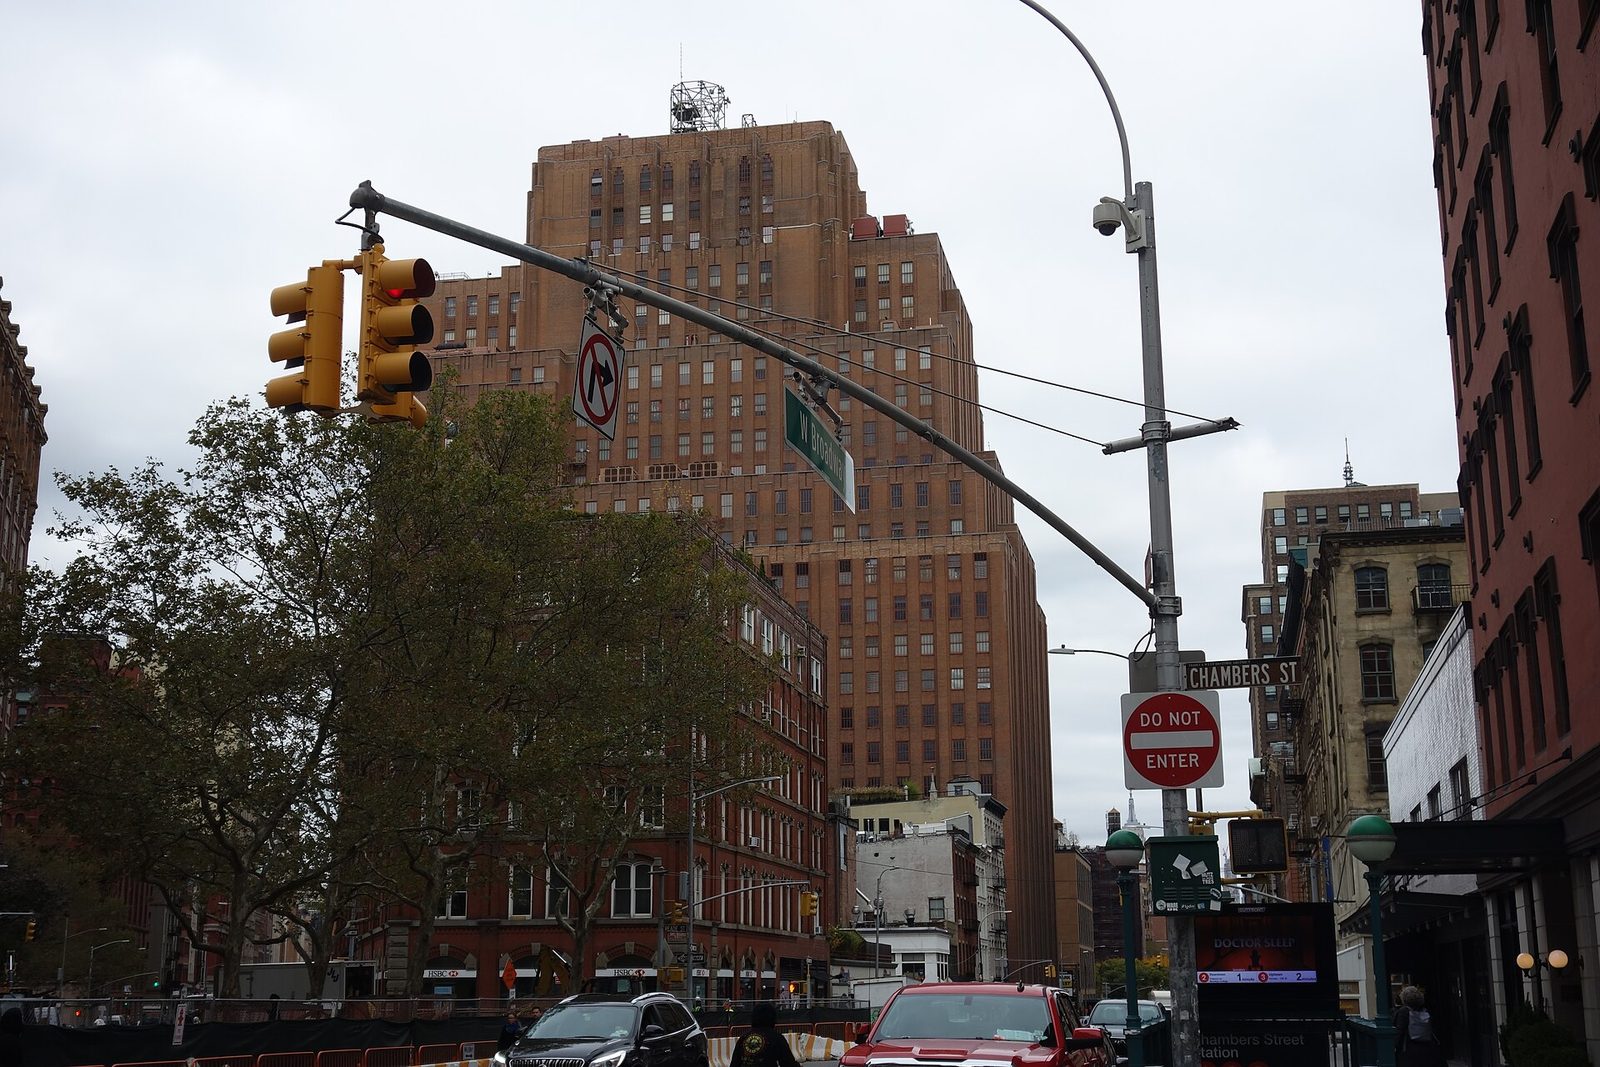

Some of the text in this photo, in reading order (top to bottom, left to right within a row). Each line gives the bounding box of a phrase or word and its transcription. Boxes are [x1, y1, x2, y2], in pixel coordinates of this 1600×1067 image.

[799, 410, 844, 481] W Broadwa
[1190, 661, 1297, 689] CHAMBERS ST
[1140, 711, 1201, 727] DO NOT
[1146, 753, 1200, 769] ENTER
[1214, 937, 1296, 948] DOCTOR SLEEP
[614, 969, 634, 977] HSBC
[1236, 973, 1242, 981] 1
[1260, 973, 1266, 981] 3
[1296, 972, 1302, 981] 2
[1201, 1033, 1305, 1046] hambers Street
[1200, 1047, 1239, 1059] tation
